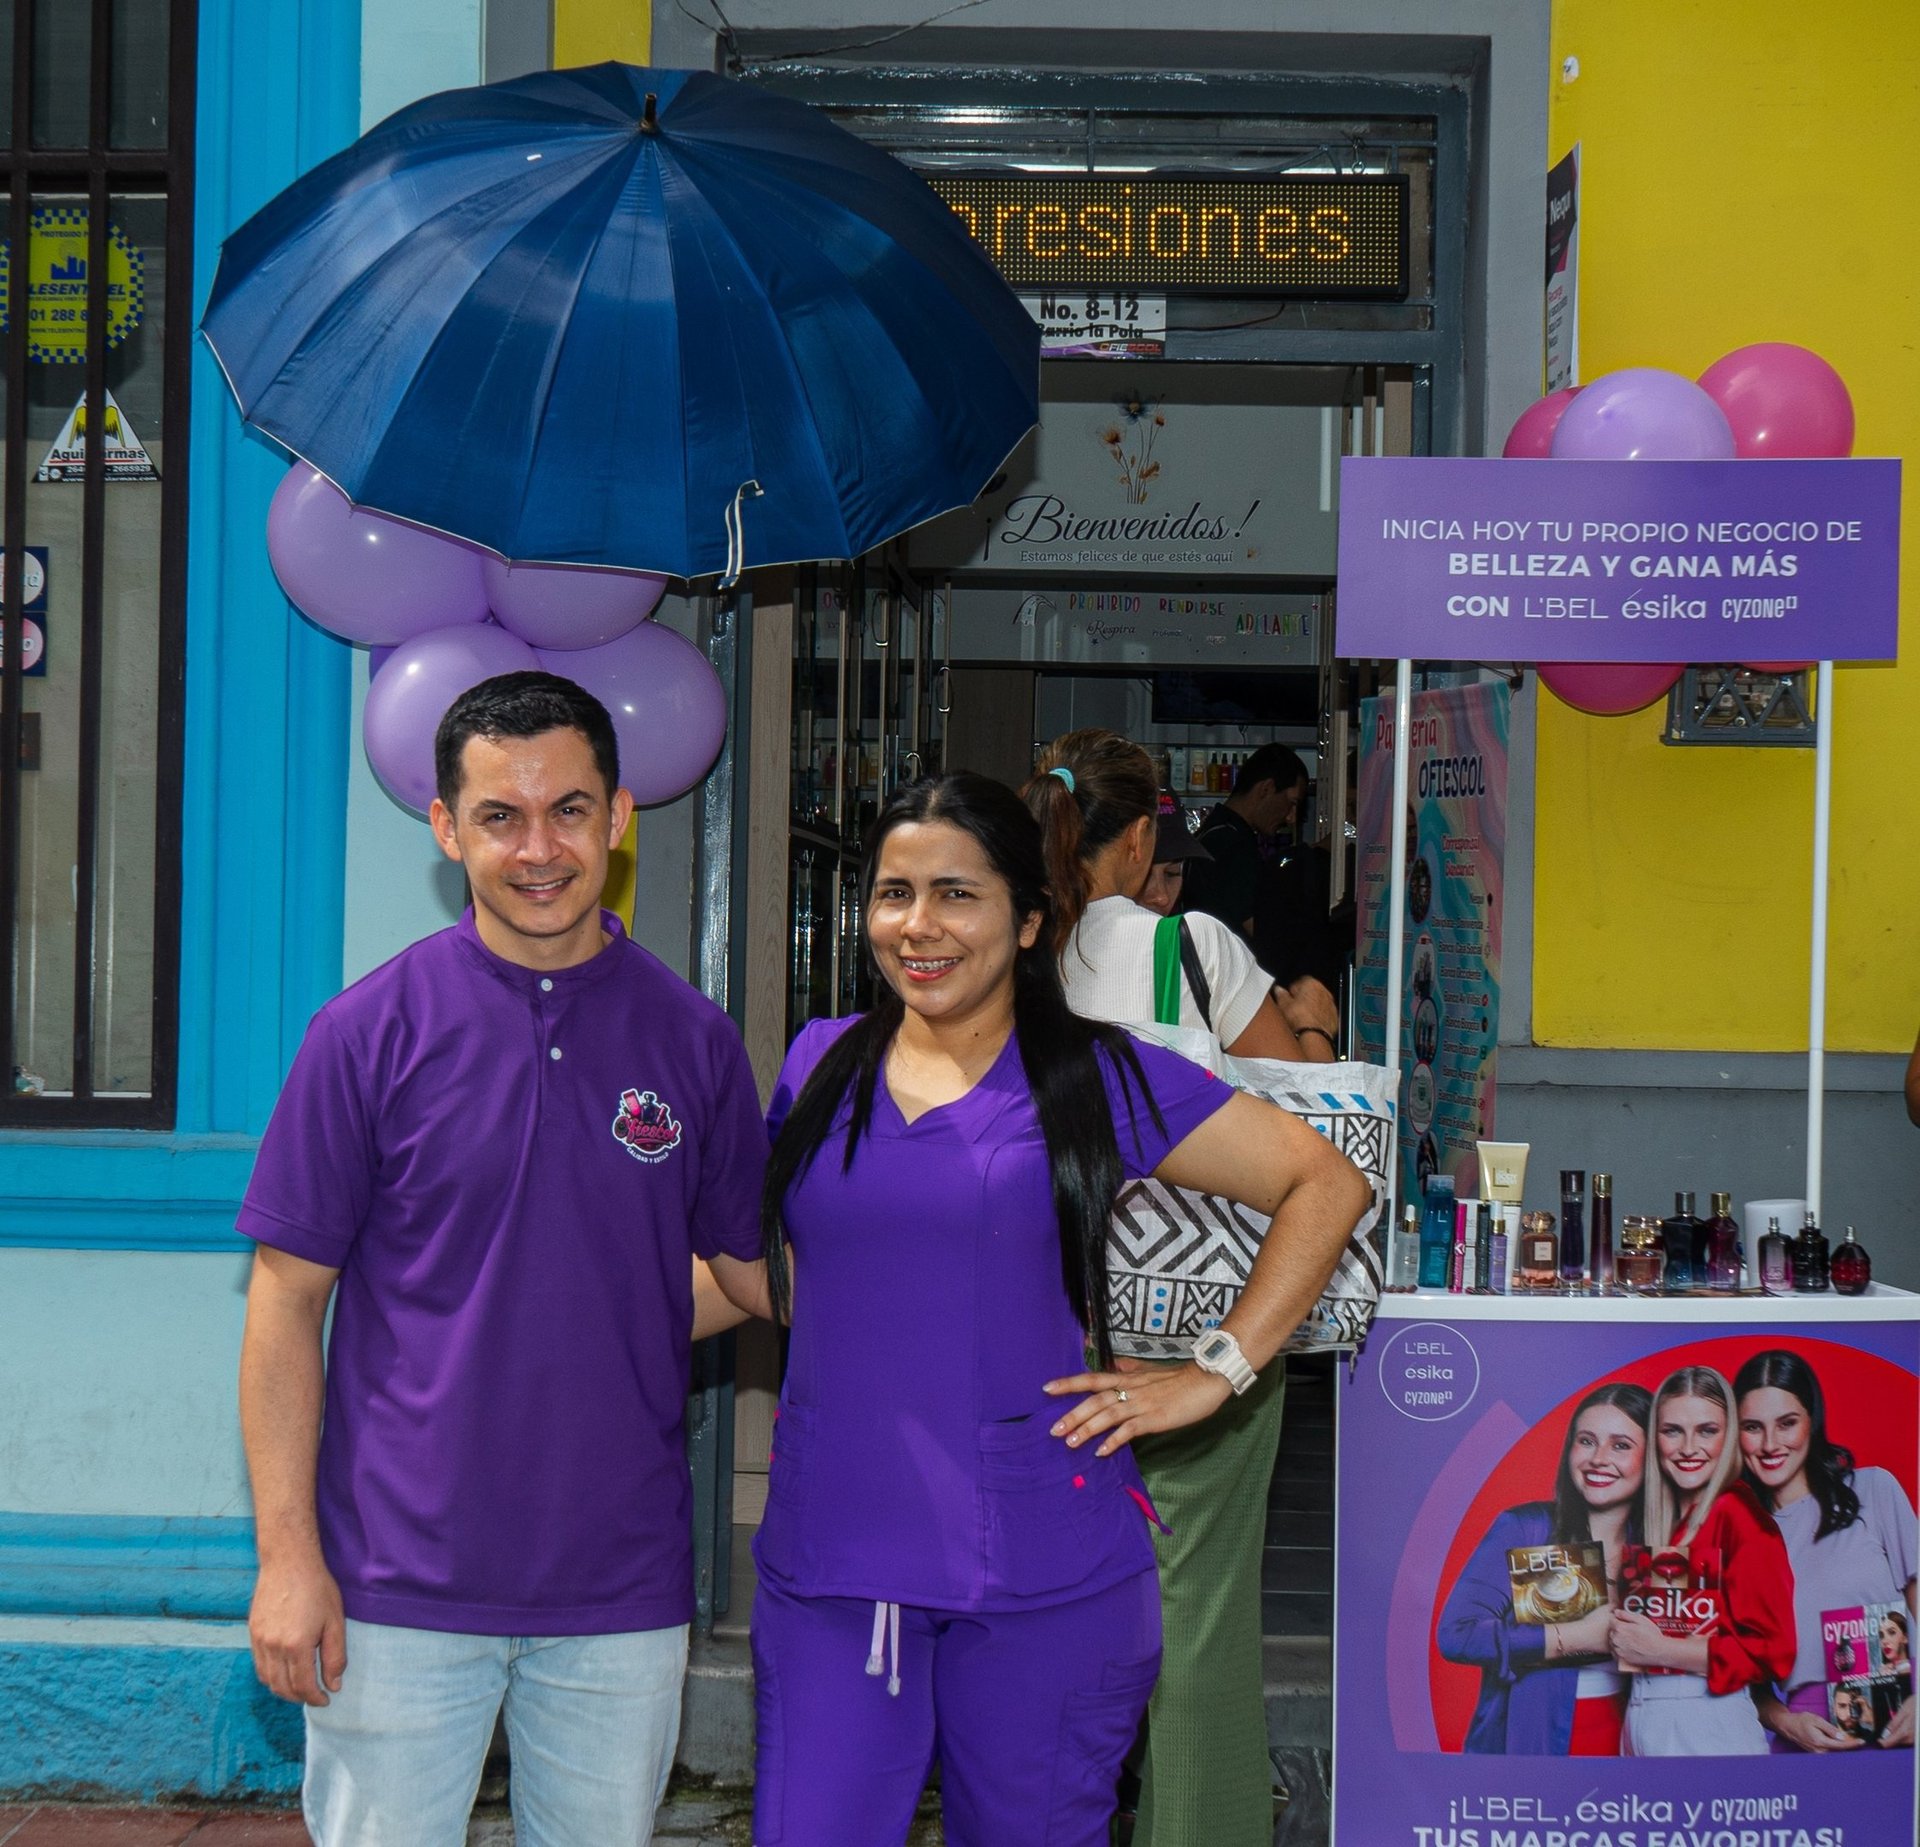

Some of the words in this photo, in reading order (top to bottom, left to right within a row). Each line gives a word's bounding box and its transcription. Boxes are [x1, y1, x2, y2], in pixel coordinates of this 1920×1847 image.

[1040, 294, 1078, 320] No.
[1085, 294, 1140, 321] 8-12
[1109, 324, 1144, 339] Pola
[1382, 519, 1464, 541] INICIA
[1474, 521, 1531, 542] HOY
[1537, 521, 1573, 542] TU
[1582, 521, 1689, 543] PROPIO
[1698, 521, 1819, 543] NEGOCIO
[1826, 521, 1862, 542] DE
[1020, 551, 1073, 562] Estamos
[1074, 551, 1118, 564] felices
[1122, 551, 1138, 562] de
[1142, 554, 1166, 564] que
[1169, 551, 1202, 563] estés
[1206, 551, 1233, 565] aquí
[1449, 553, 1591, 578] BELLEZA
[1600, 554, 1621, 577] Y
[1630, 555, 1722, 578] GANA
[1731, 548, 1799, 578] MÁS
[1070, 592, 1140, 614] PROHIBIDO
[1159, 598, 1225, 617] RENDIRSE
[1236, 613, 1310, 637] ADELANTE
[1447, 595, 1510, 617] CON
[1523, 596, 1609, 619] L'BEL
[1621, 589, 1707, 619] ésika
[1087, 619, 1137, 640] Respira
[1376, 712, 1437, 751] Paería
[1418, 755, 1485, 799] OFIESCOL
[1404, 1342, 1453, 1356] L'BEL
[1509, 1550, 1582, 1575] L'BEL
[1575, 1787, 1673, 1823] ésika
[1682, 1798, 1704, 1828] y
[1413, 1827, 1480, 1847] TUS
